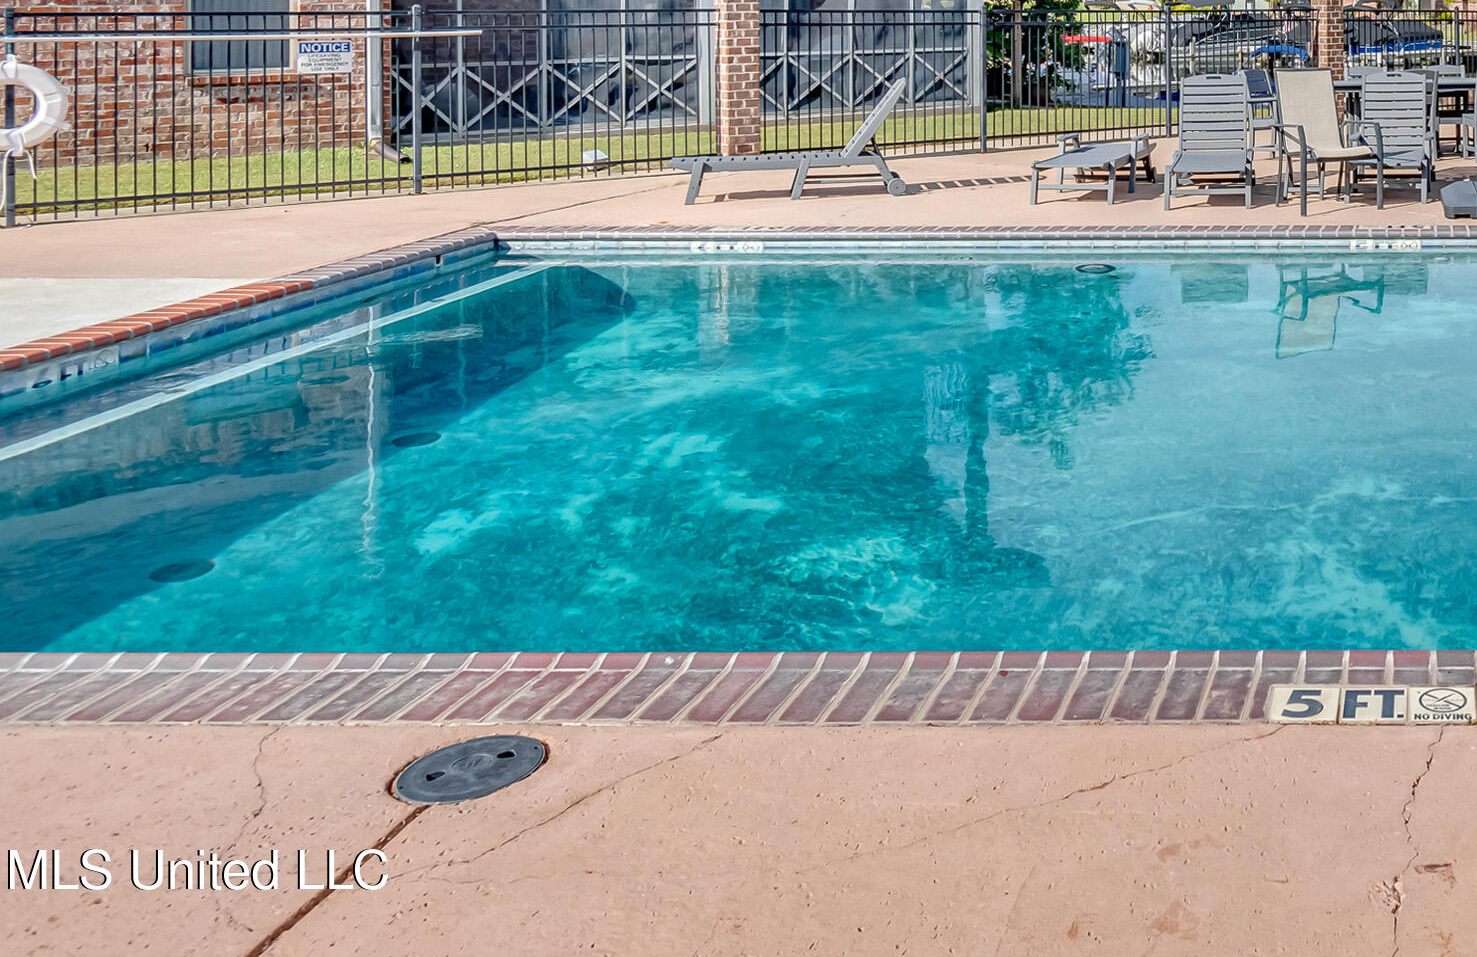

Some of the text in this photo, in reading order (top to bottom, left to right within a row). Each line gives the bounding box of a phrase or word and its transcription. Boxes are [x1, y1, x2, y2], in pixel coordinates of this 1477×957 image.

[302, 42, 349, 53] NOTICE
[1281, 689, 1324, 718] 5
[1414, 713, 1473, 722] NO DIVING
